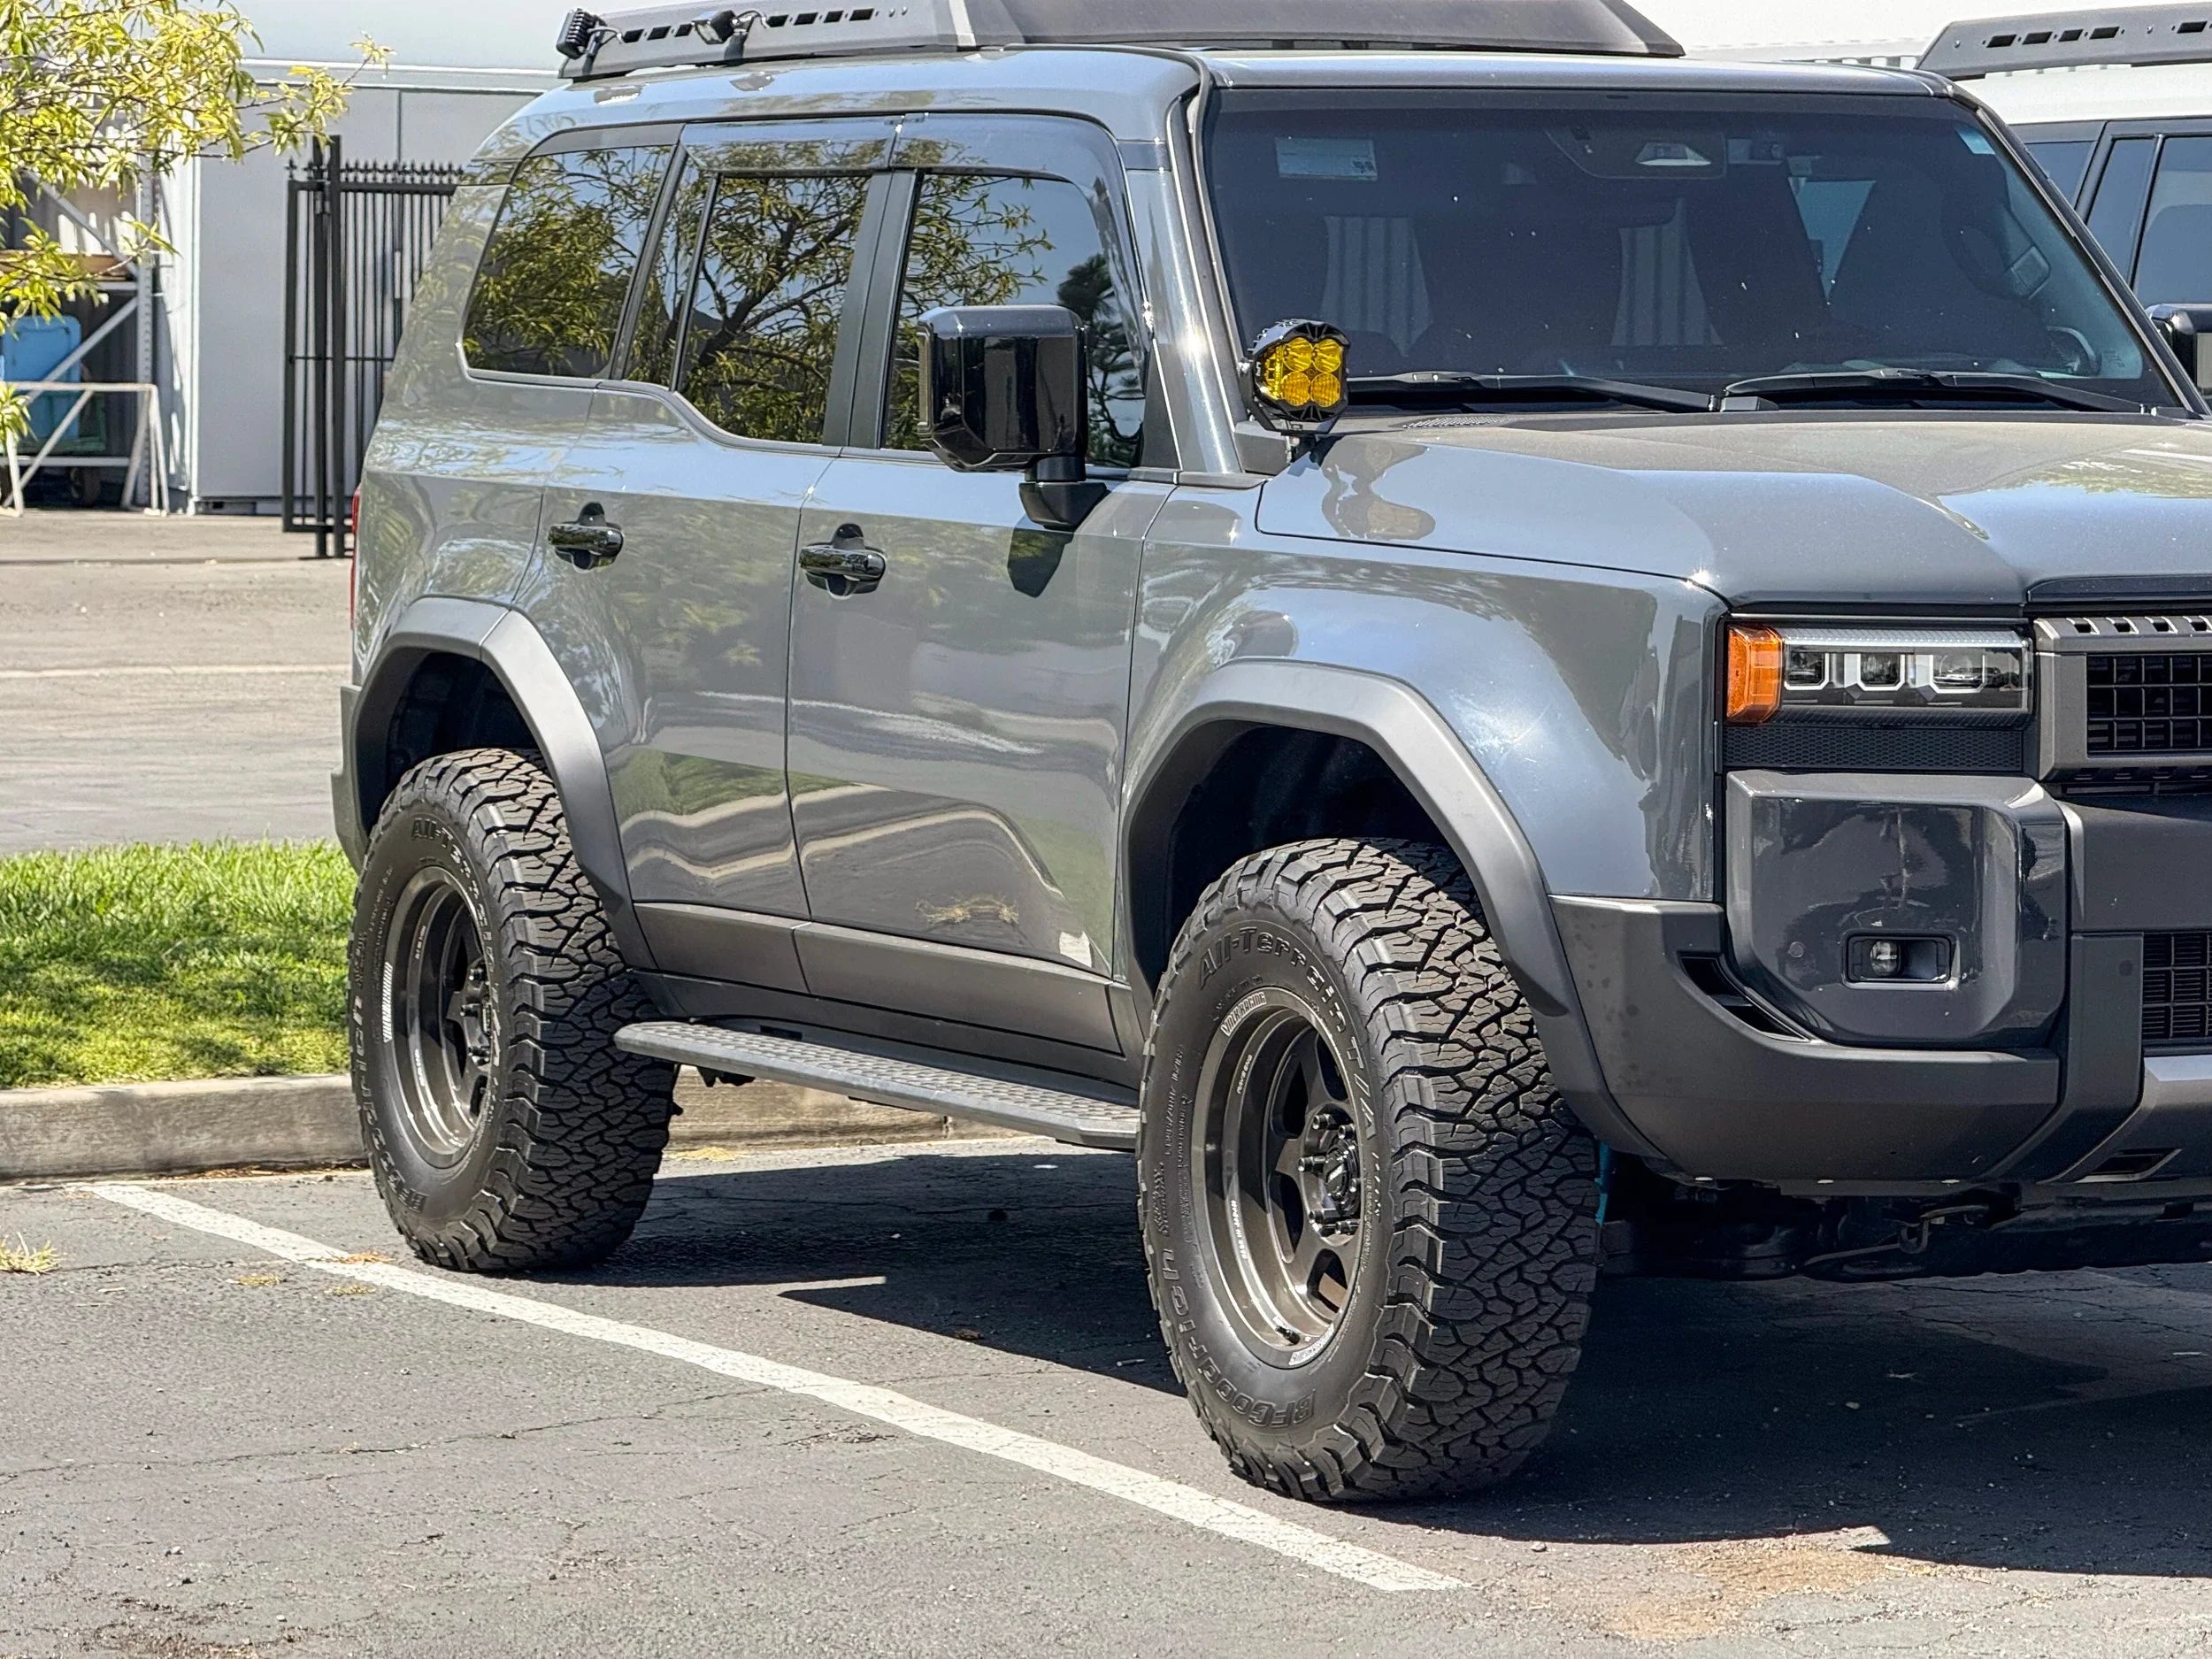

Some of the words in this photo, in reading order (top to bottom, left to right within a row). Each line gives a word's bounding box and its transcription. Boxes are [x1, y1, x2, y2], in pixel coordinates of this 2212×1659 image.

[1200, 926, 1347, 1033] All-Terrain
[1238, 991, 1267, 1018] RACING
[1162, 1248, 1316, 1428] BFGoodrich
